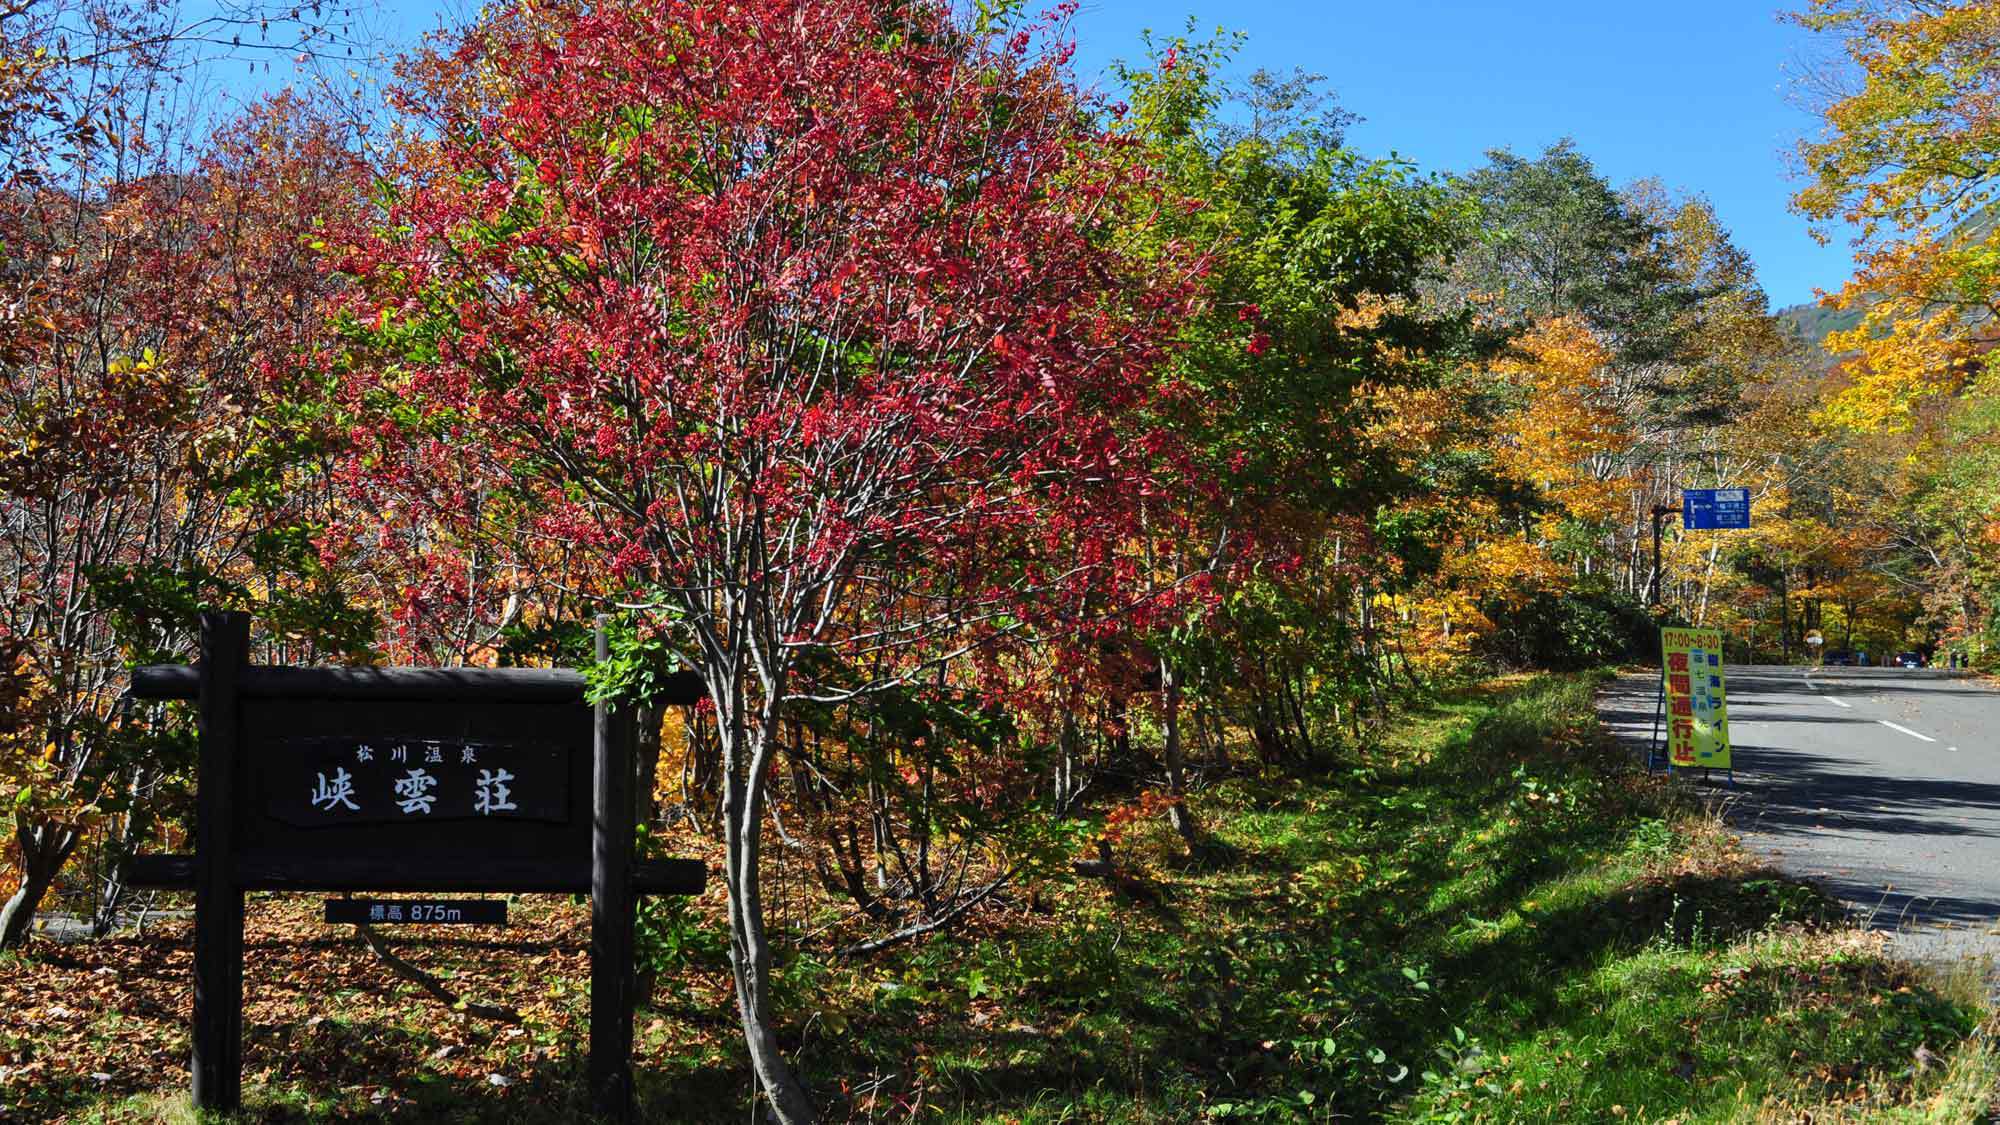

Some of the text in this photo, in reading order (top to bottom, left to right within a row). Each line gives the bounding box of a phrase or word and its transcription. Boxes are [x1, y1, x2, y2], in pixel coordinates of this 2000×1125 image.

[357, 744, 477, 763] 松川温泉
[311, 766, 517, 815] 峡雲荘
[369, 904, 461, 921] 標高 875m
